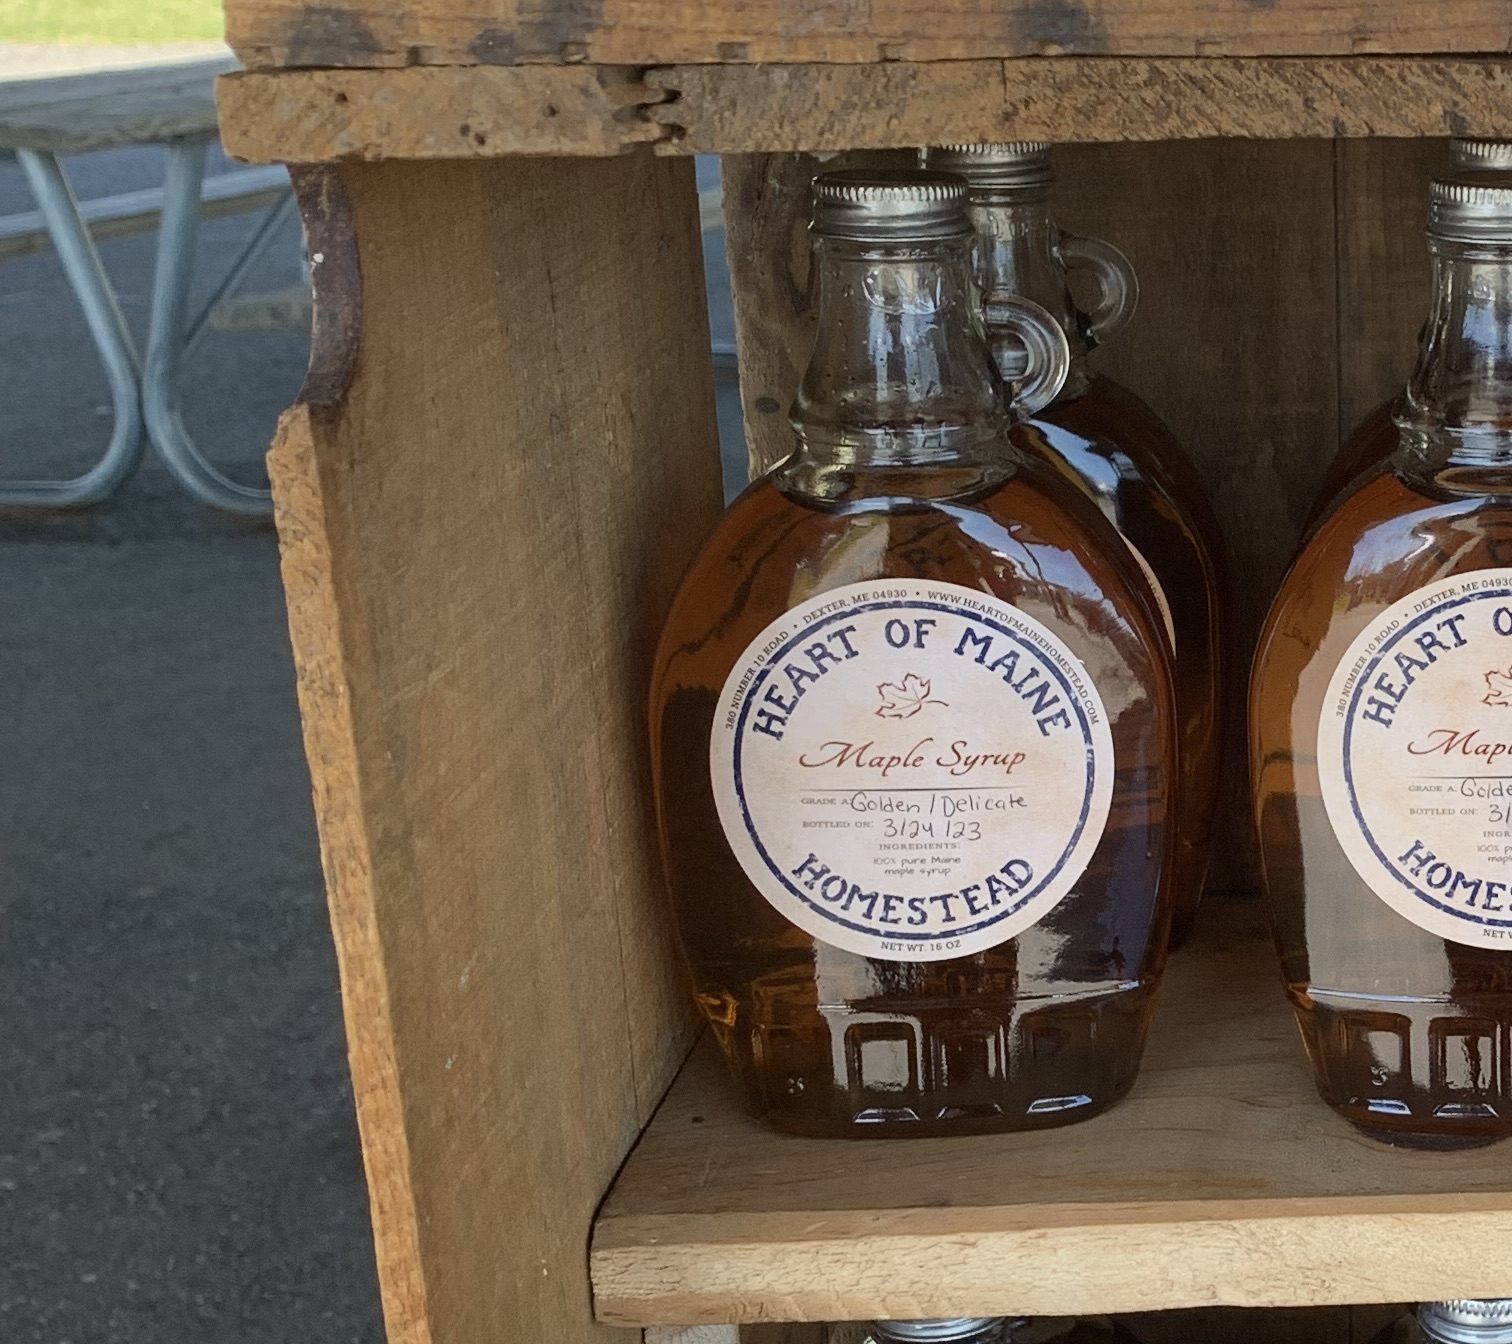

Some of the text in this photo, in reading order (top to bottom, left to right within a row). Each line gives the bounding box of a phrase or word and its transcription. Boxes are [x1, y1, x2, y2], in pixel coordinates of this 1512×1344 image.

[731, 668, 756, 710] NUMBER
[753, 655, 765, 667] 10
[764, 631, 789, 656] ROAD
[852, 594, 869, 604] ME
[873, 590, 907, 599] 04930
[928, 591, 1099, 724] WWW.HEARTOFMAINEHOMESTEAD.COM
[752, 619, 1071, 741] HEART OF MAINE
[1342, 656, 1367, 697] NUMBER
[1365, 643, 1376, 655] 10
[1376, 620, 1400, 645] ROAD
[1461, 582, 1478, 592] ME
[1363, 614, 1467, 729] HEART
[799, 738, 1025, 777] Maple Syrup
[791, 853, 1033, 926] HOMESTEAD
[1483, 929, 1504, 938] NET
[881, 942, 903, 950] NET
[931, 943, 942, 951] 16
[946, 940, 962, 950] OZ
